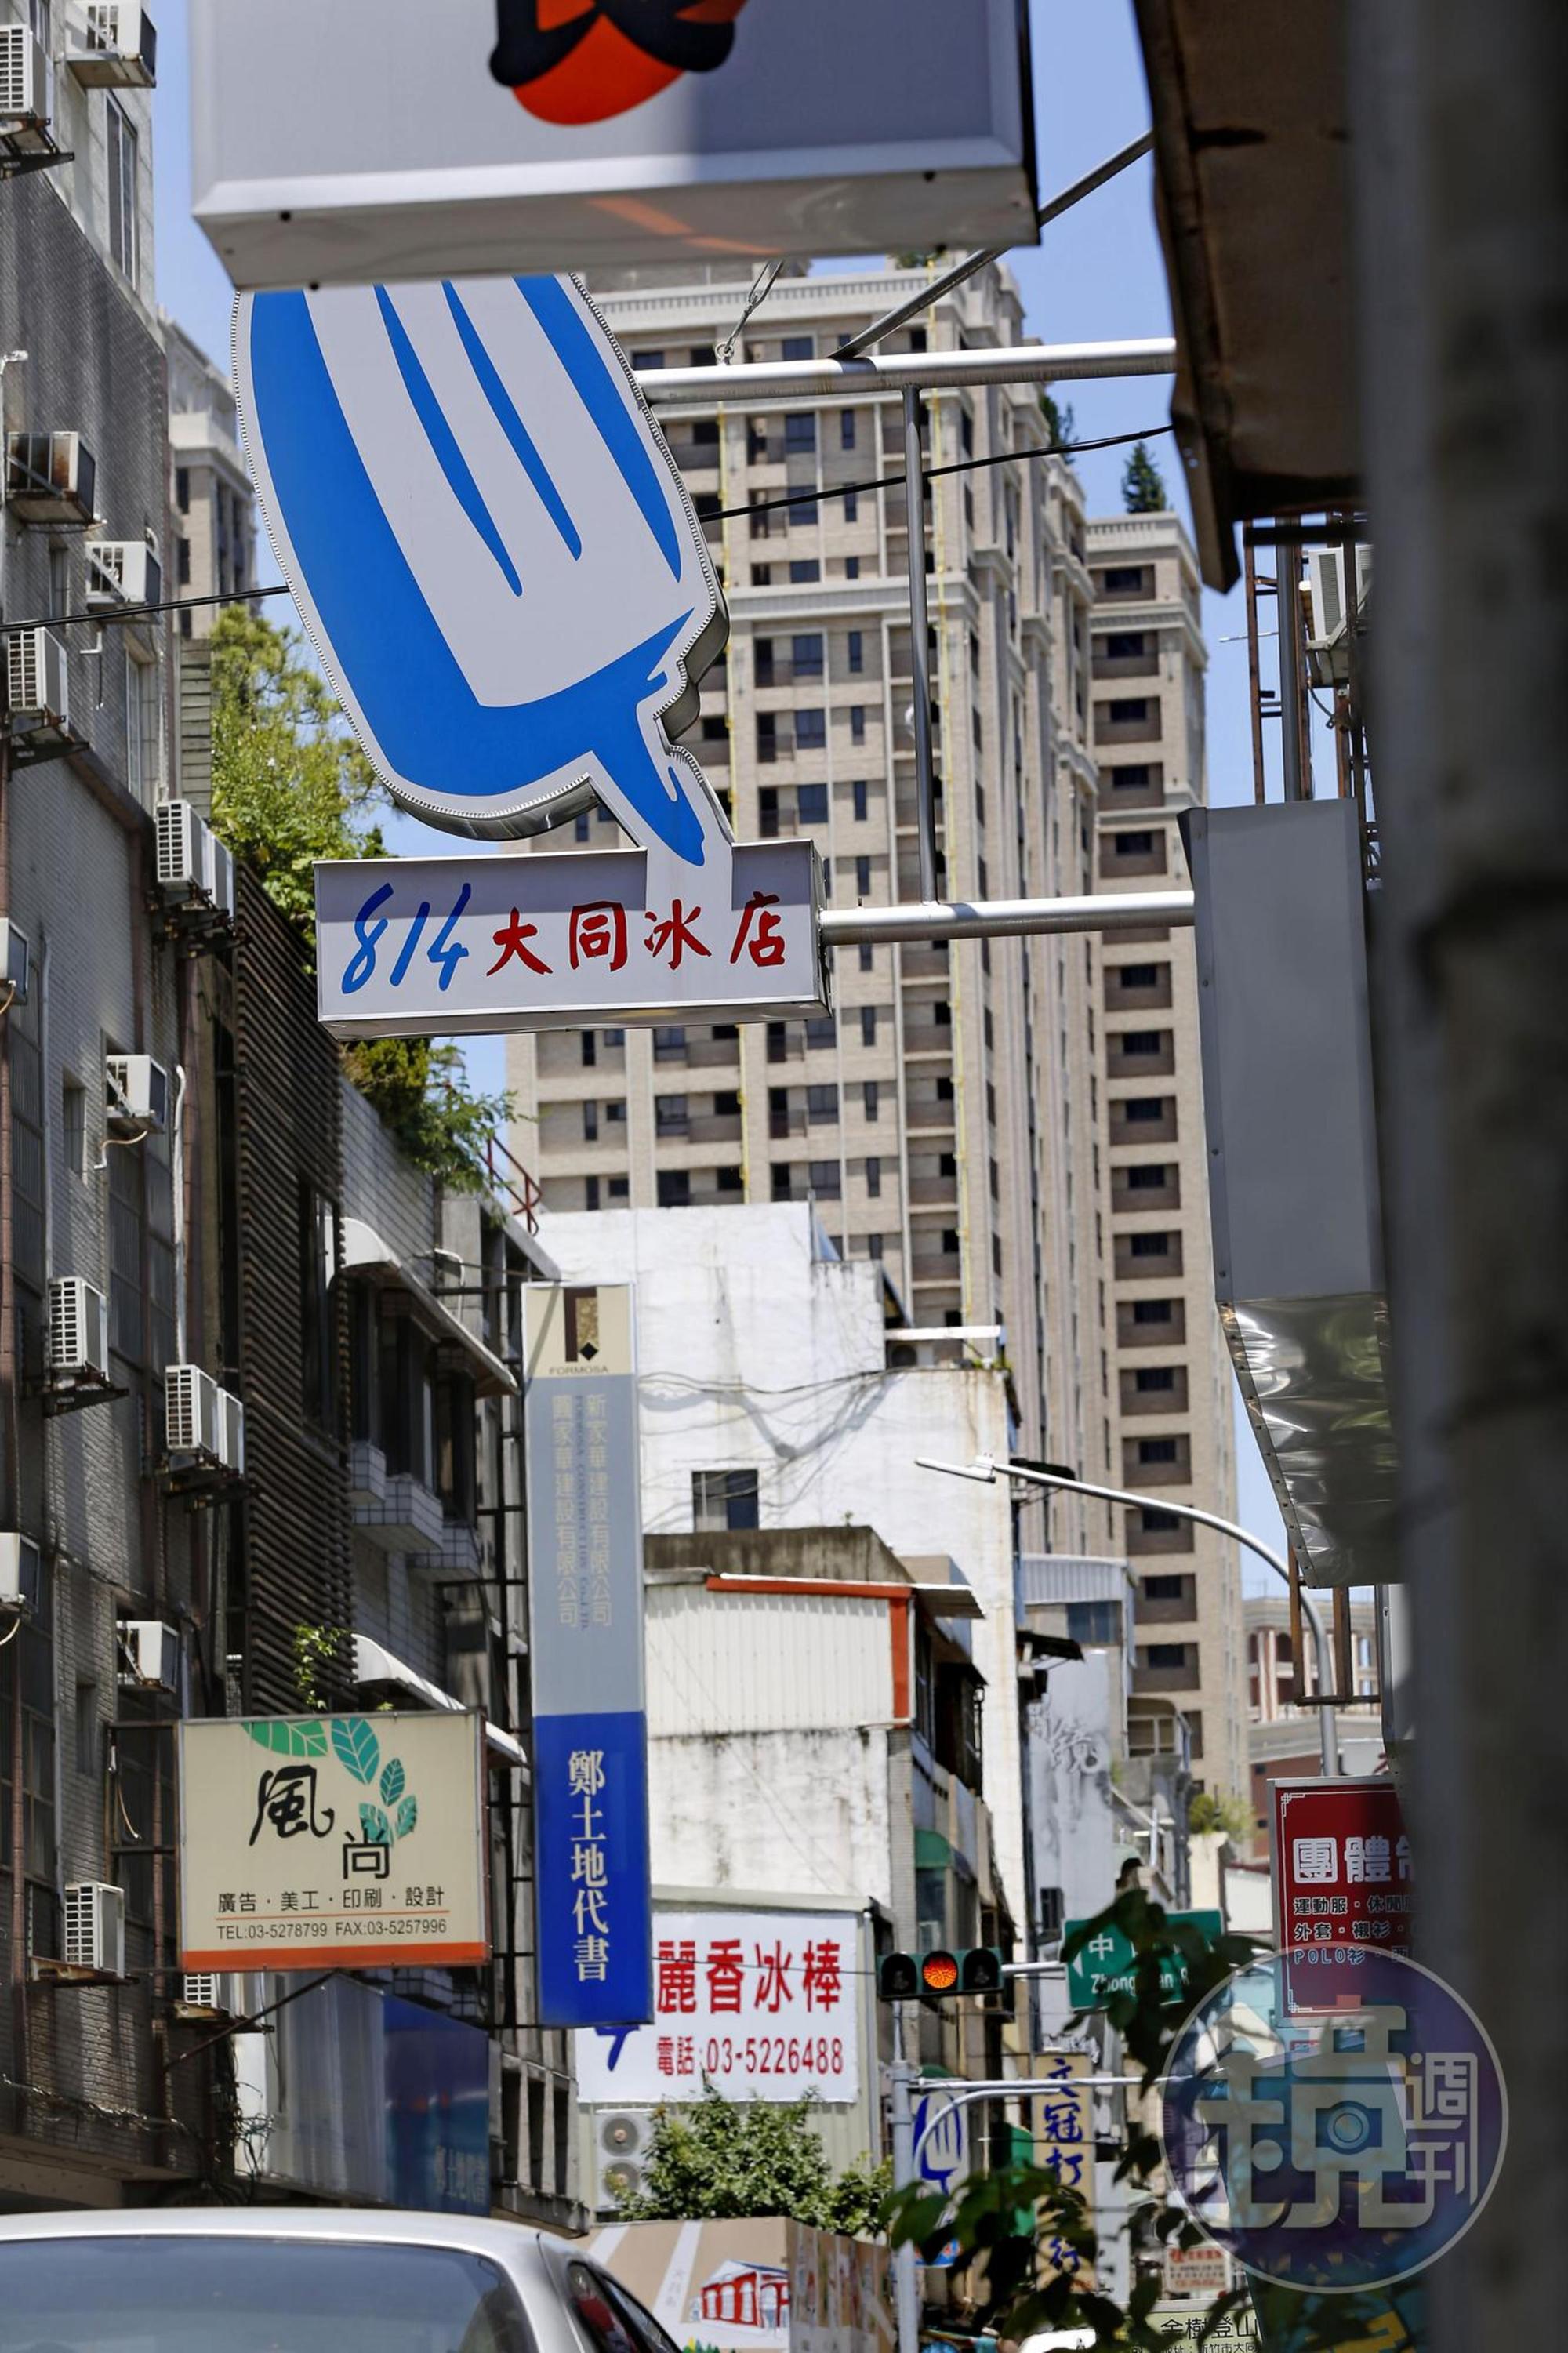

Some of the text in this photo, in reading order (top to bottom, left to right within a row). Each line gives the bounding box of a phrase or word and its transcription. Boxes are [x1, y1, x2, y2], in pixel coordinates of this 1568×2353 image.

[341, 882, 786, 994] 814 大同冰店
[550, 1365, 609, 1375] FORMOSA
[249, 1764, 390, 1881] 風尚
[568, 1749, 610, 1982] 鄭土地代書
[216, 1919, 447, 1940] TEL:03-5278799 FAX:03-5257996
[656, 1939, 842, 2013] 麗香冰棒
[1044, 2057, 1083, 2272] 文冠打行
